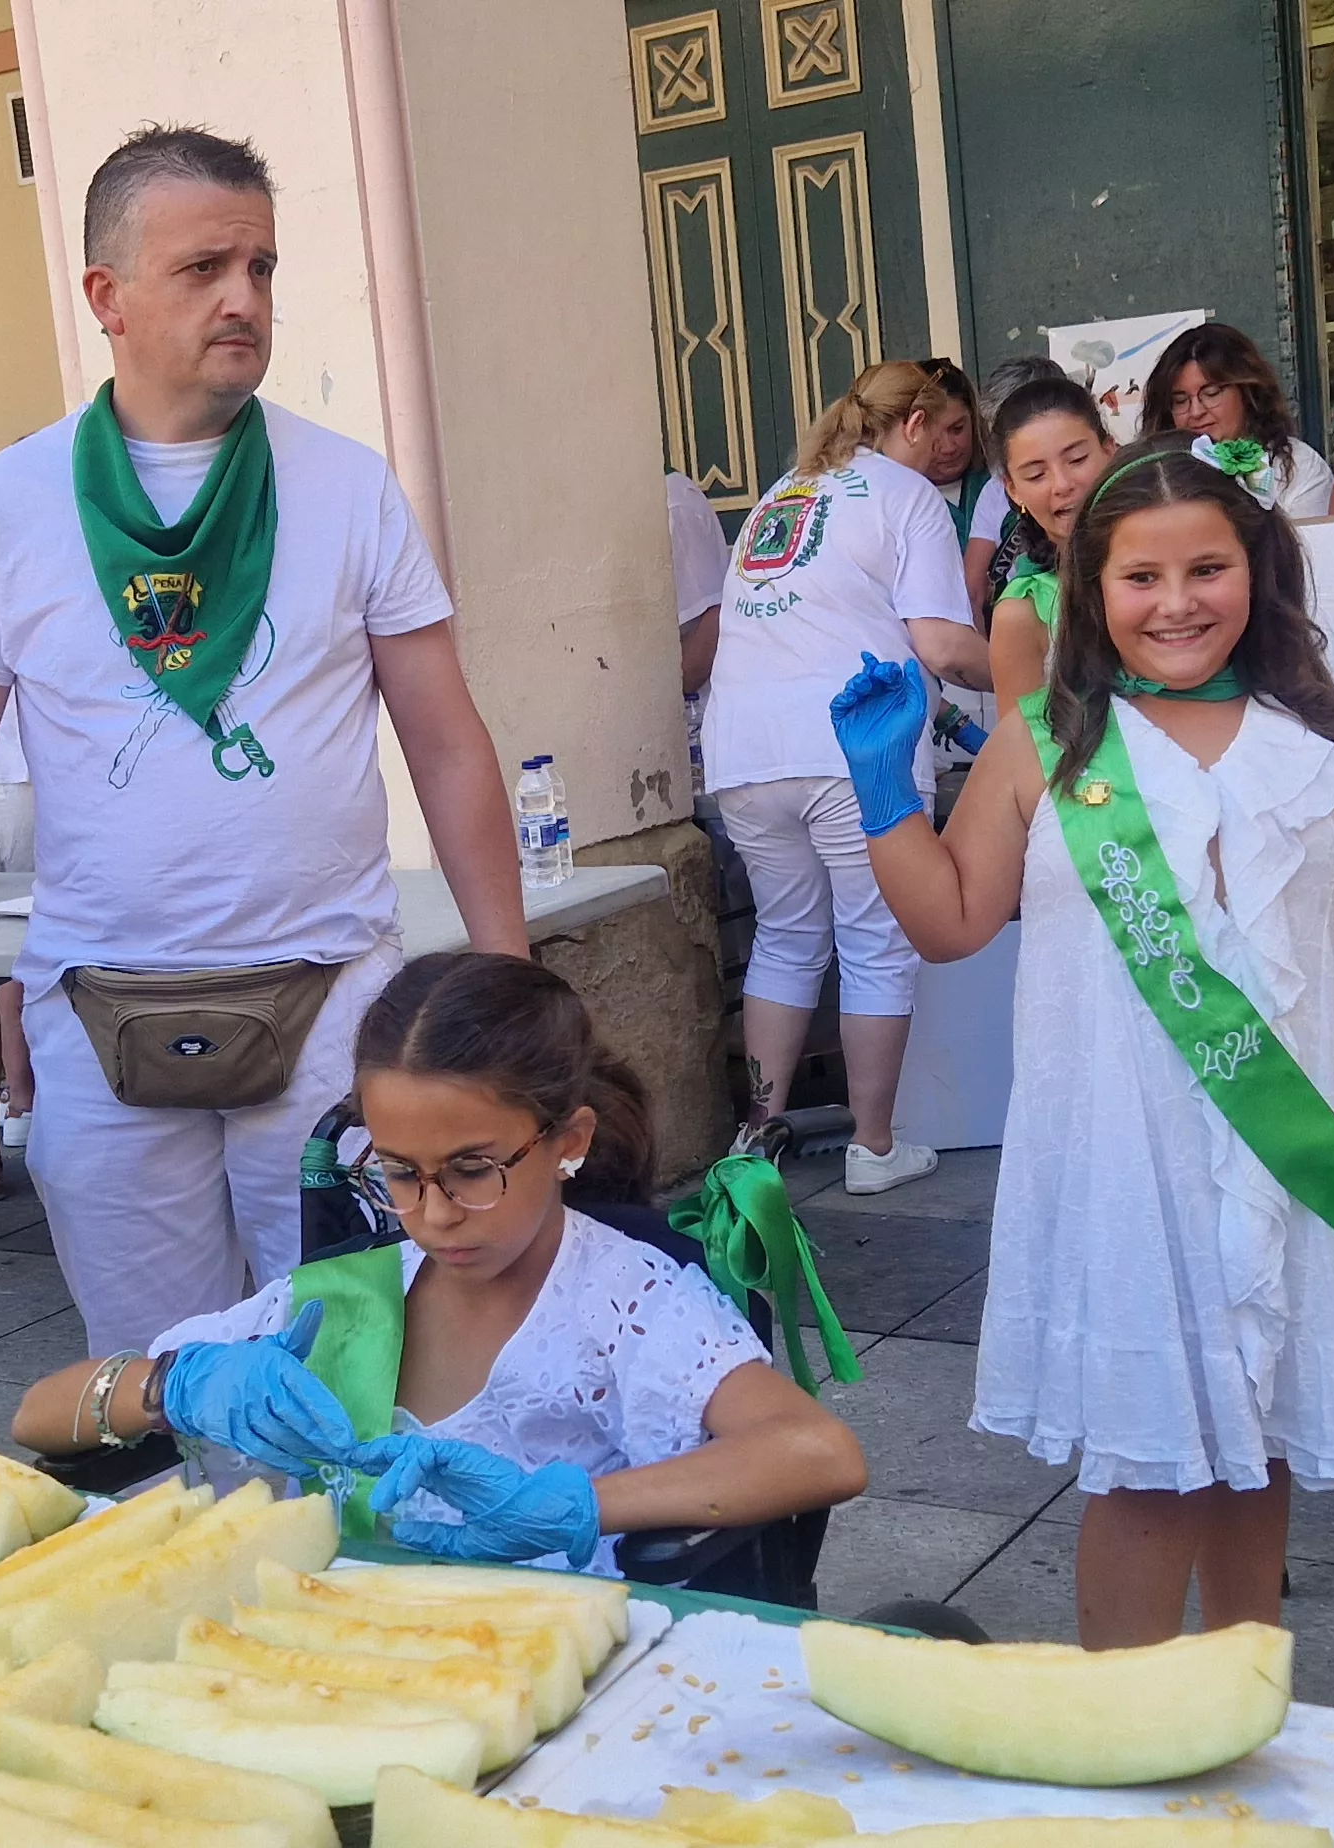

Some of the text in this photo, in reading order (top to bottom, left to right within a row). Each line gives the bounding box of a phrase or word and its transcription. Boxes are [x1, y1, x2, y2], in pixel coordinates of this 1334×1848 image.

[153, 576, 183, 589] PEÑA
[735, 591, 803, 618] HUESCA
[1195, 1023, 1262, 1081] 2024
